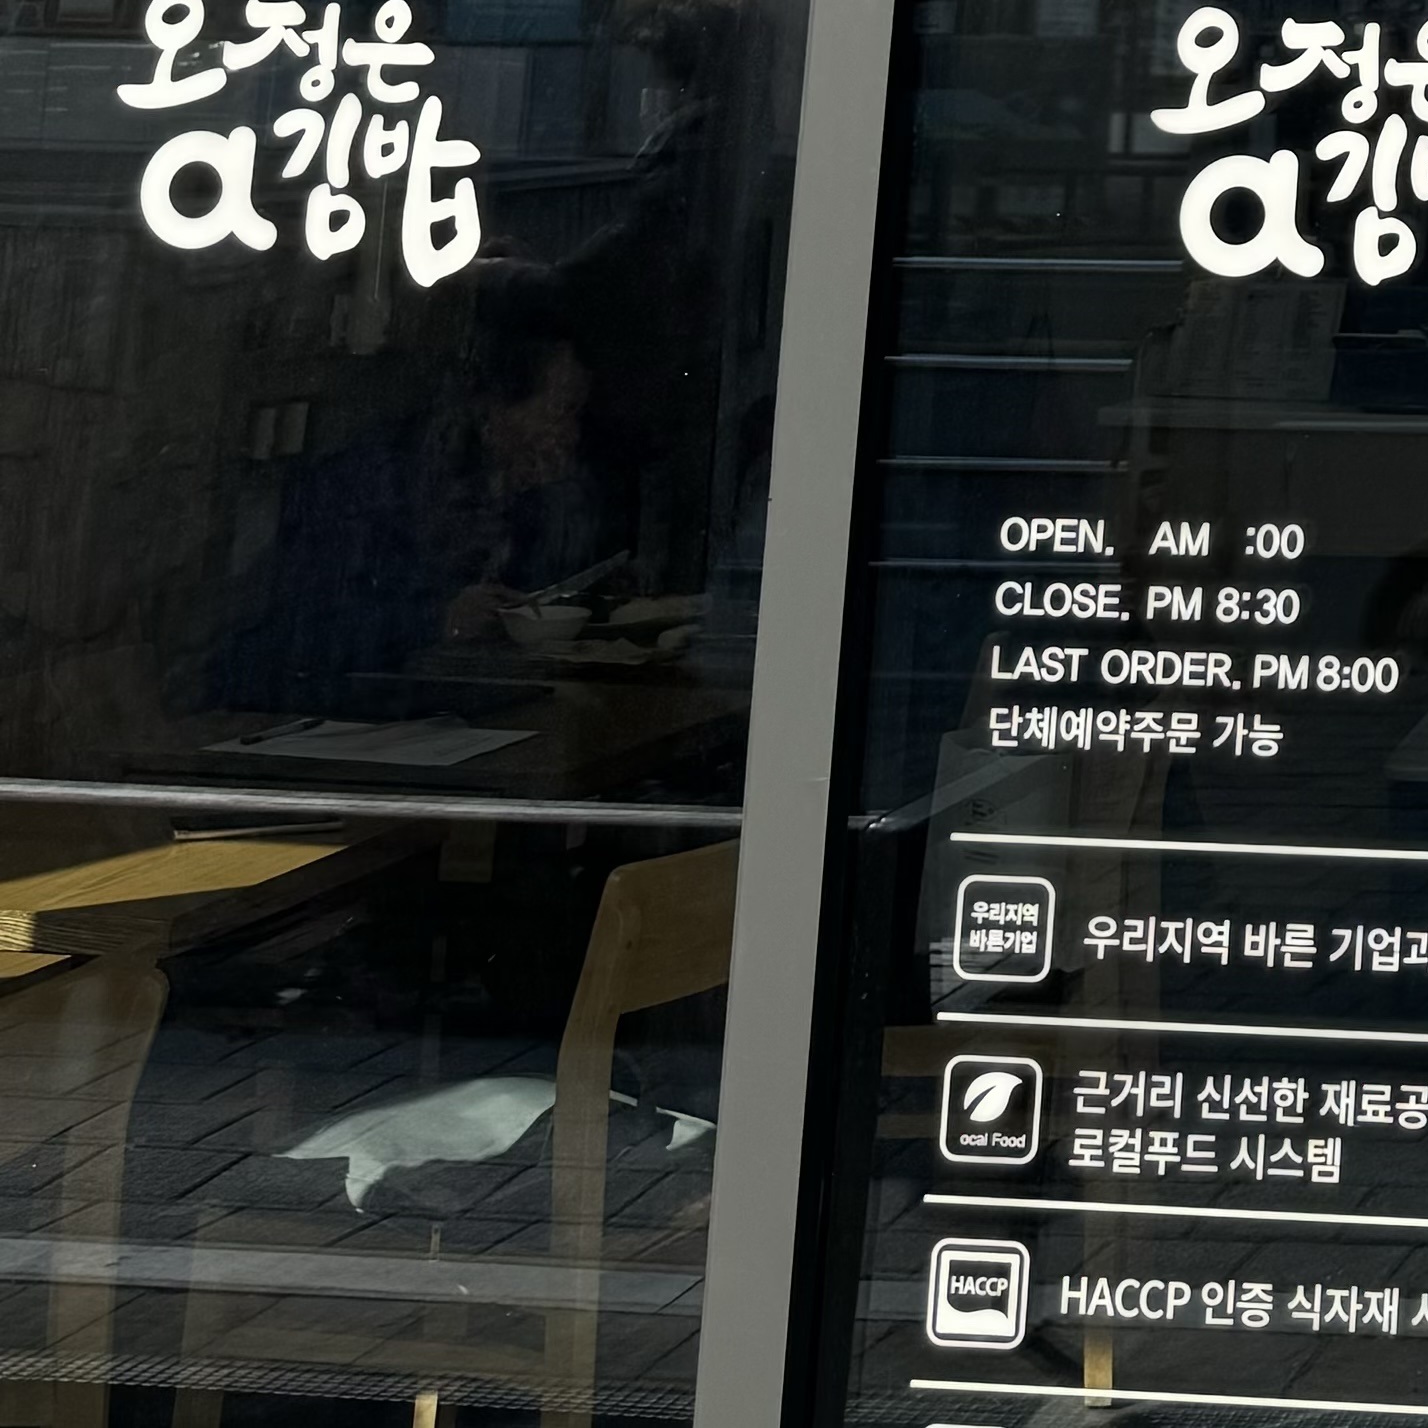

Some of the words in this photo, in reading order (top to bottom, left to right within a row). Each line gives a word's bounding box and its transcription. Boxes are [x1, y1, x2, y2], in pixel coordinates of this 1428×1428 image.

[273, 92, 481, 288] 김밥
[1000, 516, 1115, 556] OPEN.
[1148, 521, 1210, 557] AM
[1245, 523, 1305, 560] :00
[995, 581, 1130, 621] CLOSE.
[1146, 585, 1203, 621] PM
[1215, 586, 1300, 625] 8:30
[990, 645, 1089, 683] LAST
[1100, 648, 1241, 690] ORDER.
[1316, 655, 1399, 694] 8:00
[988, 704, 1202, 754] 단체예약주문
[1212, 712, 1284, 757] 가능
[971, 901, 1040, 926] 우리지역
[969, 929, 1037, 953] 바른기업
[1083, 915, 1231, 967] 우리지역
[1243, 921, 1317, 969] 바른
[1072, 1070, 1183, 1119] 근거리
[1196, 1074, 1310, 1124] 신선한
[960, 1133, 988, 1146] ocal
[992, 1133, 1026, 1148] Food
[1067, 1127, 1220, 1176] 로컬푸드
[1229, 1136, 1342, 1184] 시스템
[950, 1274, 1009, 1299] HACCP
[1060, 1275, 1192, 1320] HACCP
[1201, 1279, 1274, 1328] 인증
[1287, 1283, 1400, 1335] 식자재
